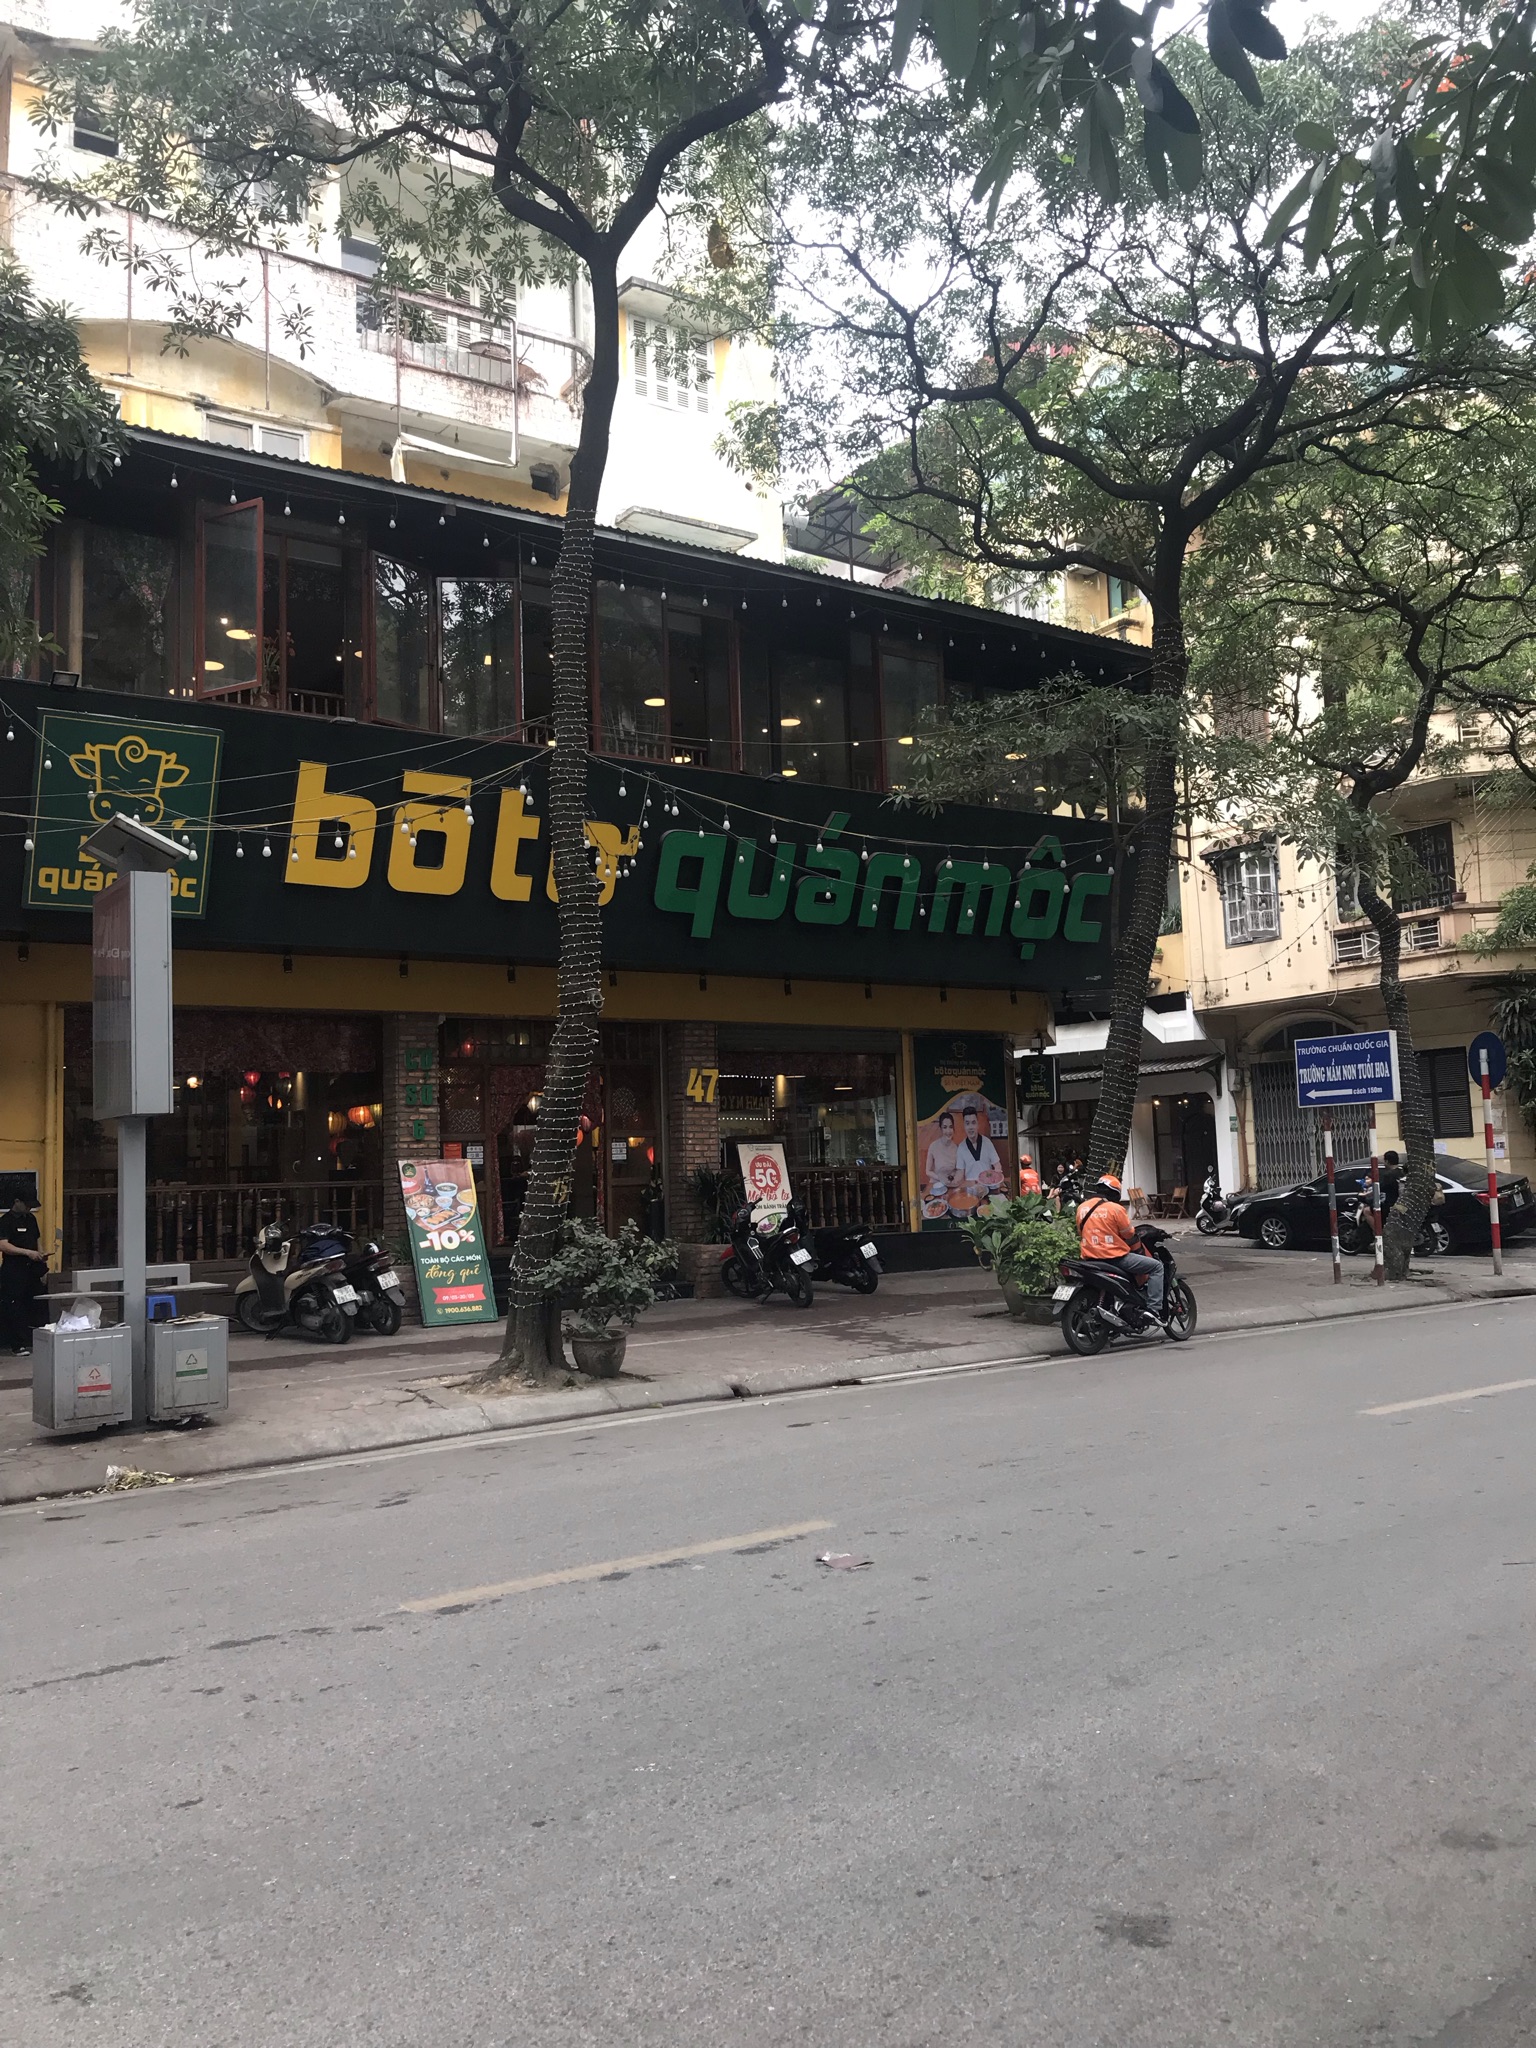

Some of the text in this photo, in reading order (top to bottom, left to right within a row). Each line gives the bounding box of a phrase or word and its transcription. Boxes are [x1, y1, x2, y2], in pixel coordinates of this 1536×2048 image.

[654, 811, 922, 938] quán
[928, 834, 1112, 960] mộc
[1297, 1045, 1327, 1056] TRƯỜNG
[1353, 1039, 1374, 1050] QUỐC
[1376, 1040, 1389, 1049] GIA
[1299, 1063, 1326, 1084] TRƯỜNG
[1342, 1064, 1357, 1081] NON
[1374, 1061, 1390, 1078] HOA
[686, 1067, 719, 1103] 47
[1368, 1086, 1382, 1094] 150m
[419, 1229, 476, 1251] -10%
[421, 1256, 439, 1264] TOÀN
[451, 1254, 465, 1262] CÁC
[466, 1253, 481, 1261] MÓN
[460, 1264, 481, 1284] quê
